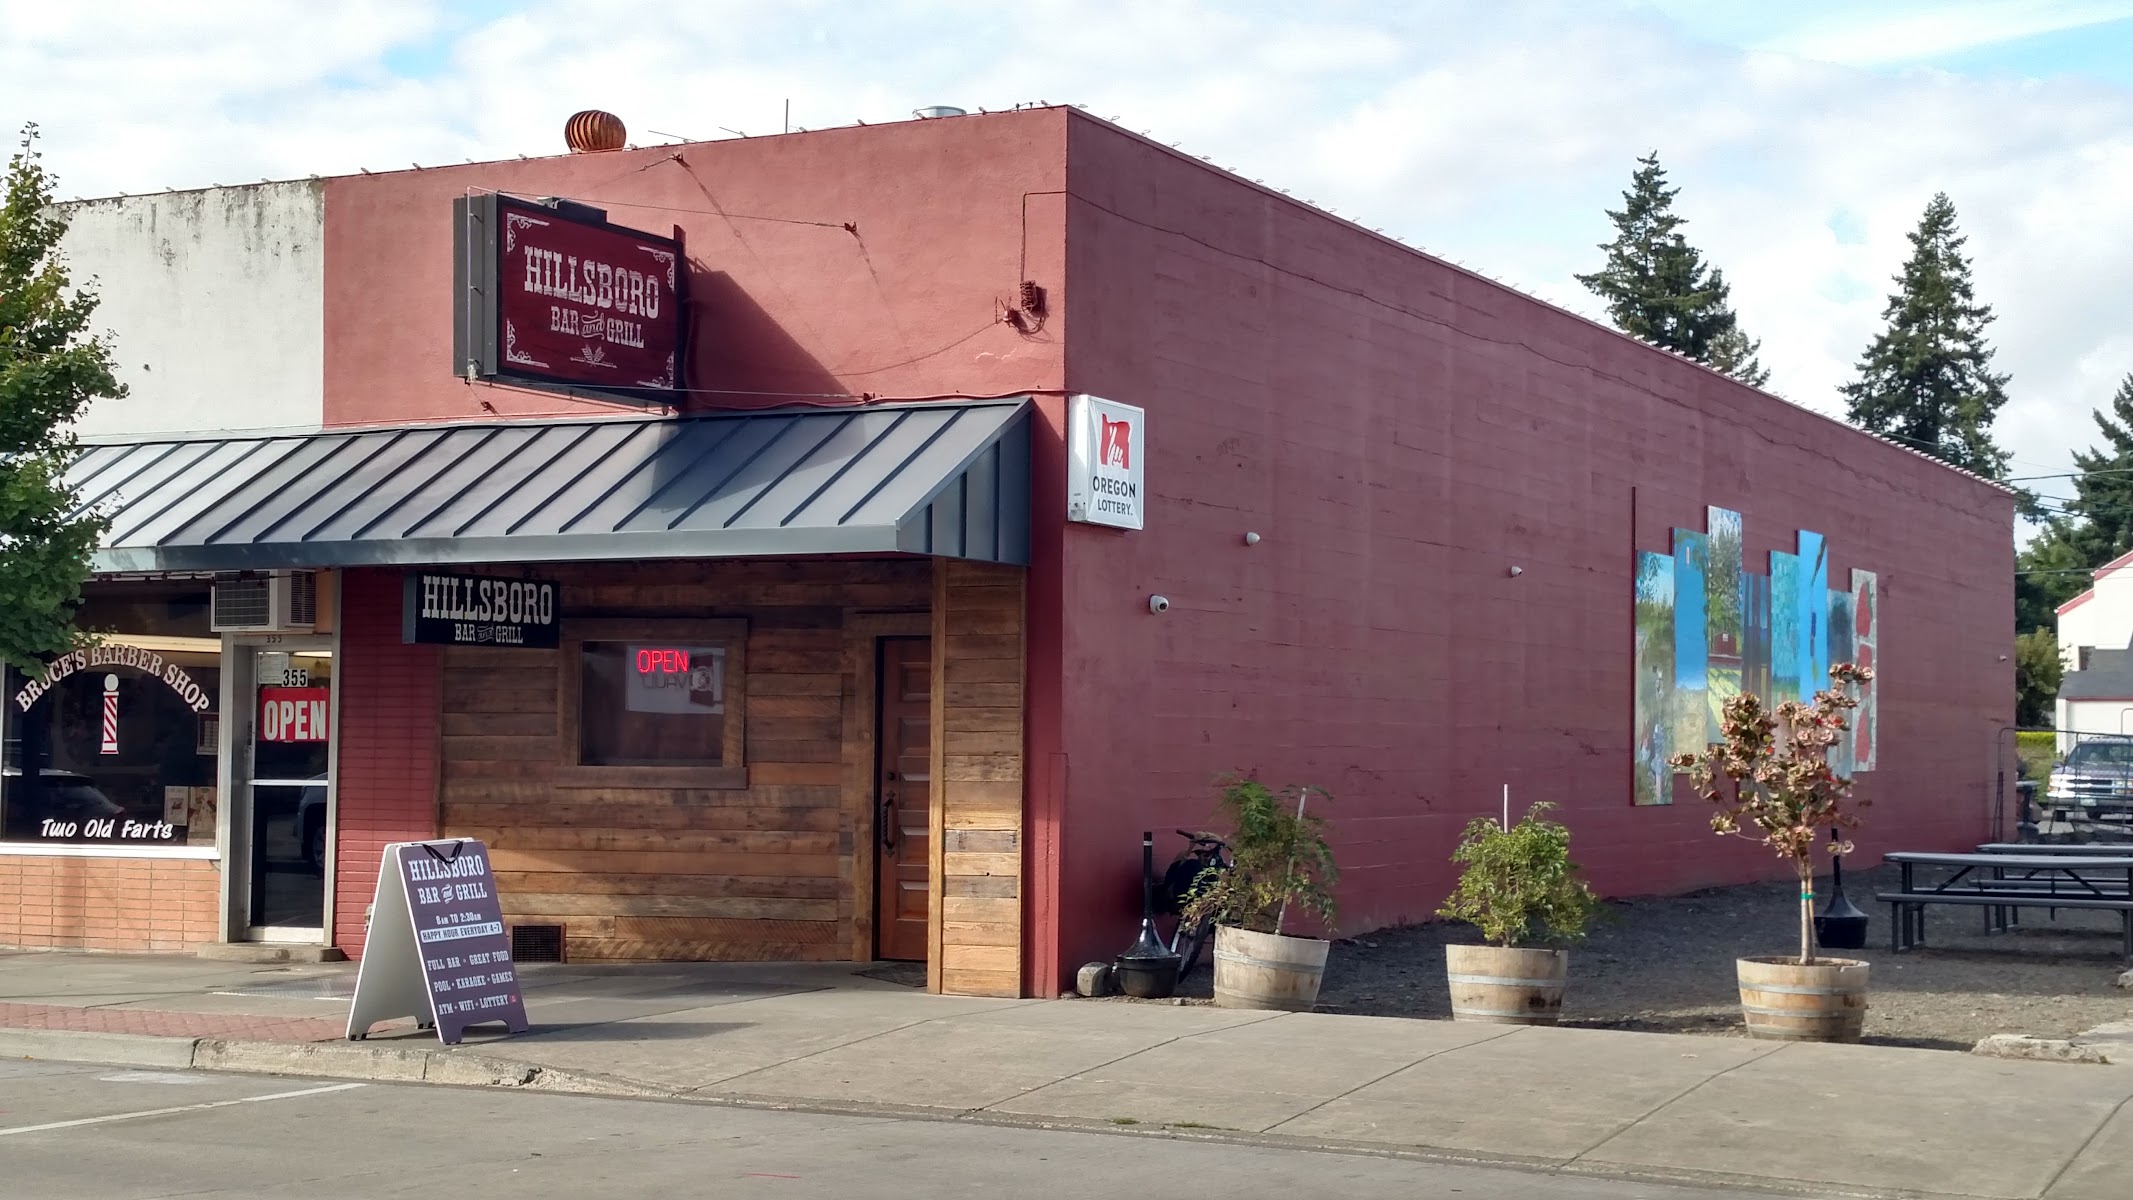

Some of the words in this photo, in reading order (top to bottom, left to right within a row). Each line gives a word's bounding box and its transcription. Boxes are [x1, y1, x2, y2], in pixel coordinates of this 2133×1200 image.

[524, 245, 659, 319] HILLSBORO
[550, 306, 580, 336] BAR
[581, 312, 605, 339] and
[606, 318, 644, 349] GRILL
[1092, 475, 1136, 498] OREGON
[1097, 499, 1132, 516] LOTTERY
[422, 575, 552, 625] HILLSBORO
[455, 623, 476, 642] BAR
[495, 626, 523, 644] GRILL
[637, 649, 689, 673] OPEN
[91, 644, 163, 677] BARBER
[163, 663, 210, 713] SHOP
[283, 669, 306, 686] 355
[264, 700, 326, 740] OPEN
[41, 818, 77, 838] Two
[84, 818, 115, 838] Old
[121, 819, 174, 839] Farts
[408, 855, 485, 881] HILLSBORO
[417, 886, 441, 905] BAR
[455, 882, 488, 901] GRILL
[450, 913, 459, 923] TO
[422, 931, 441, 940] HAPPY
[443, 929, 460, 939] HOUR
[460, 926, 490, 937] EVERYDAY
[490, 923, 500, 932] 4-7
[427, 959, 446, 971] FULL
[446, 957, 461, 968] BAR
[469, 953, 490, 966] GREAT
[492, 950, 509, 962] FOOD
[433, 980, 451, 993] POOL
[456, 975, 486, 989] KARAOKE
[491, 971, 514, 984] GAMES
[438, 1003, 454, 1015] ATM
[458, 1000, 475, 1012] WIFI
[479, 994, 509, 1009] LOTTERY
